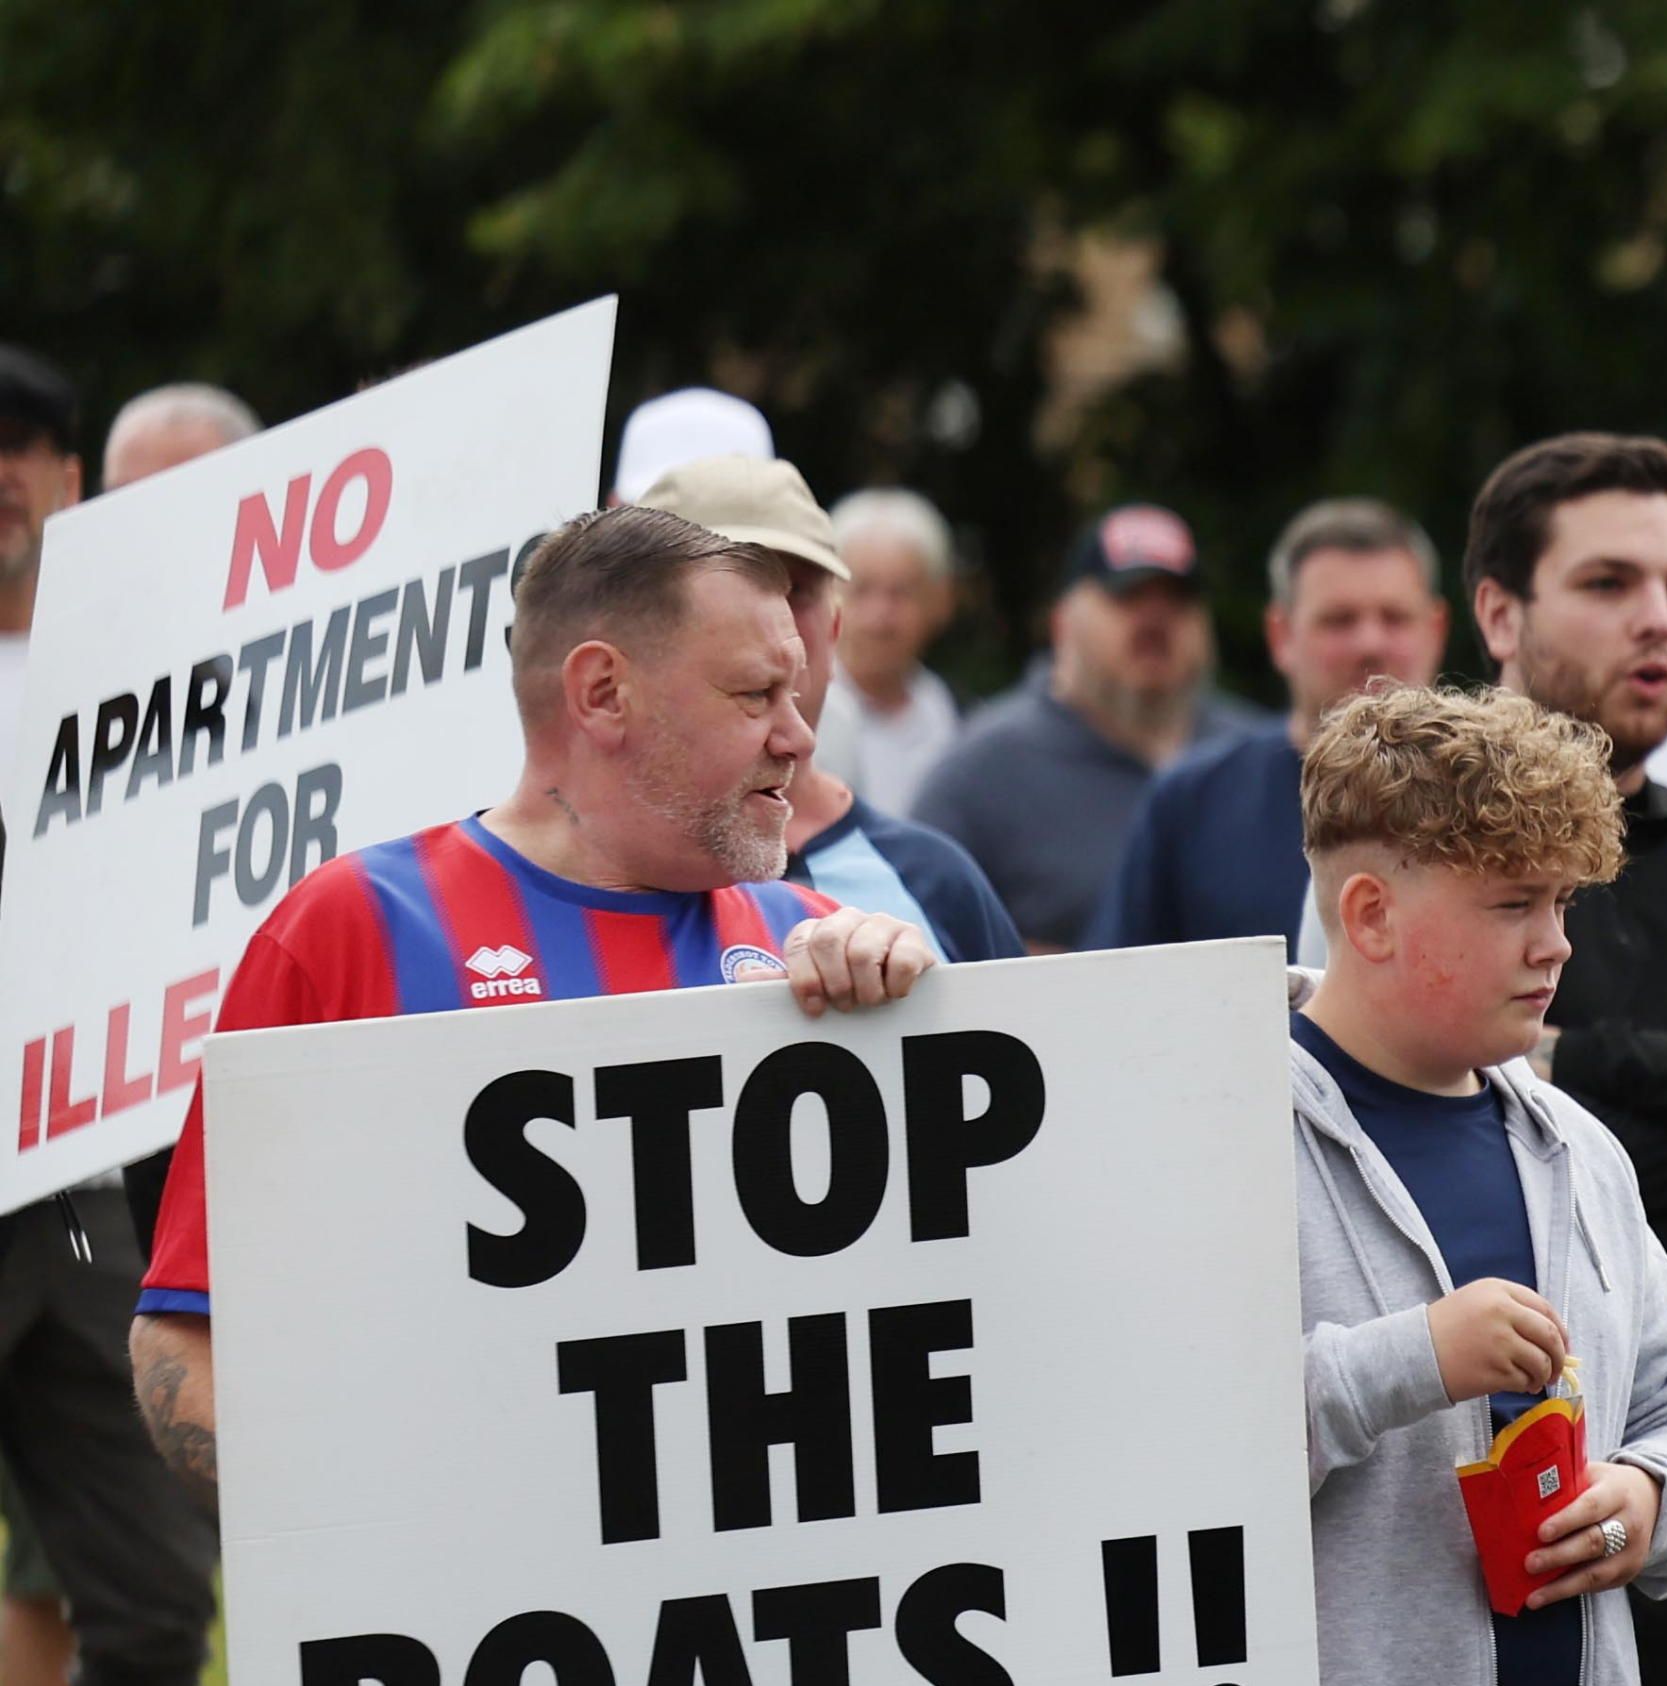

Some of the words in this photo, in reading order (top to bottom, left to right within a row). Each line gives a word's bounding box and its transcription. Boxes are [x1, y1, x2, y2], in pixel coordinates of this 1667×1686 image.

[226, 447, 392, 608] NO
[33, 534, 546, 837] APARTMENT
[193, 763, 342, 928] FOR
[18, 967, 219, 1155] ILLE
[462, 1029, 1047, 1289] STOP
[555, 1297, 982, 1546] THE
